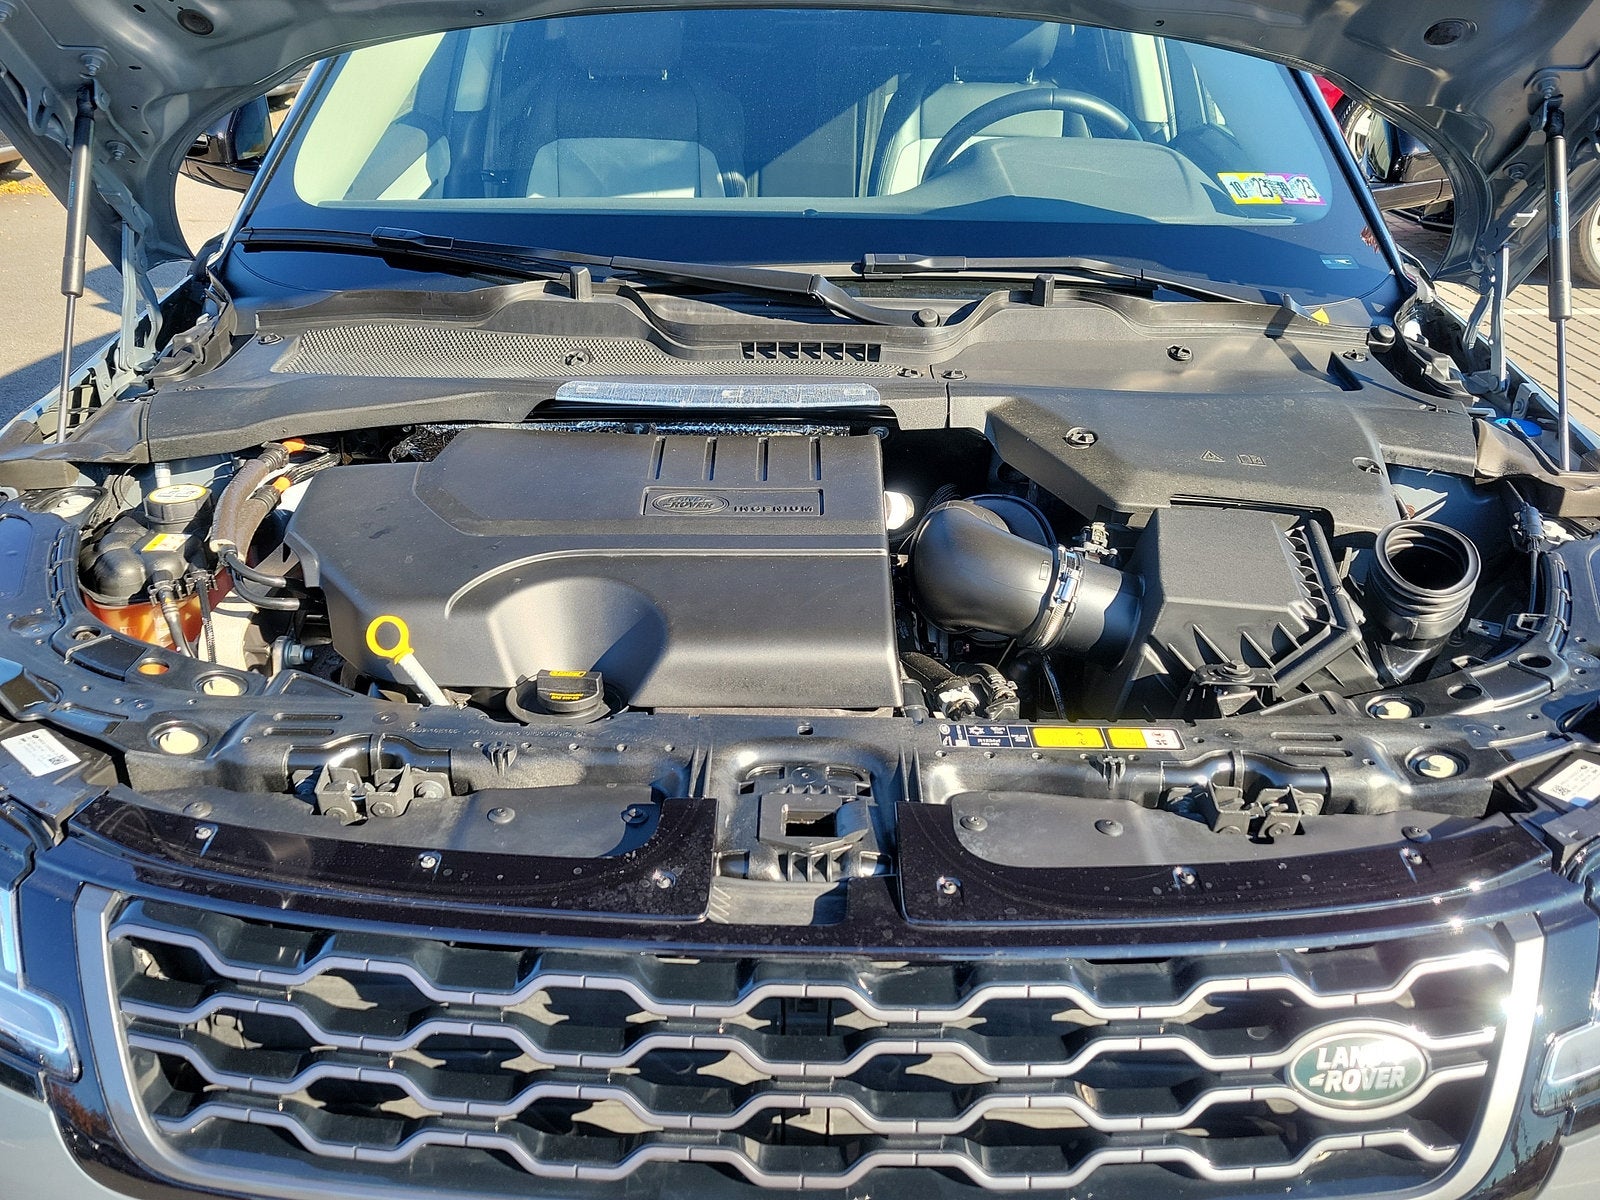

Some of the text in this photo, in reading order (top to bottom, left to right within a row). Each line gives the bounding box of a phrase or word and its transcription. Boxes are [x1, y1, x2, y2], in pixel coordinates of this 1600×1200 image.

[1250, 177, 1274, 198] 23
[733, 505, 814, 513] INGENIUM
[1324, 1066, 1405, 1093] ROVER
